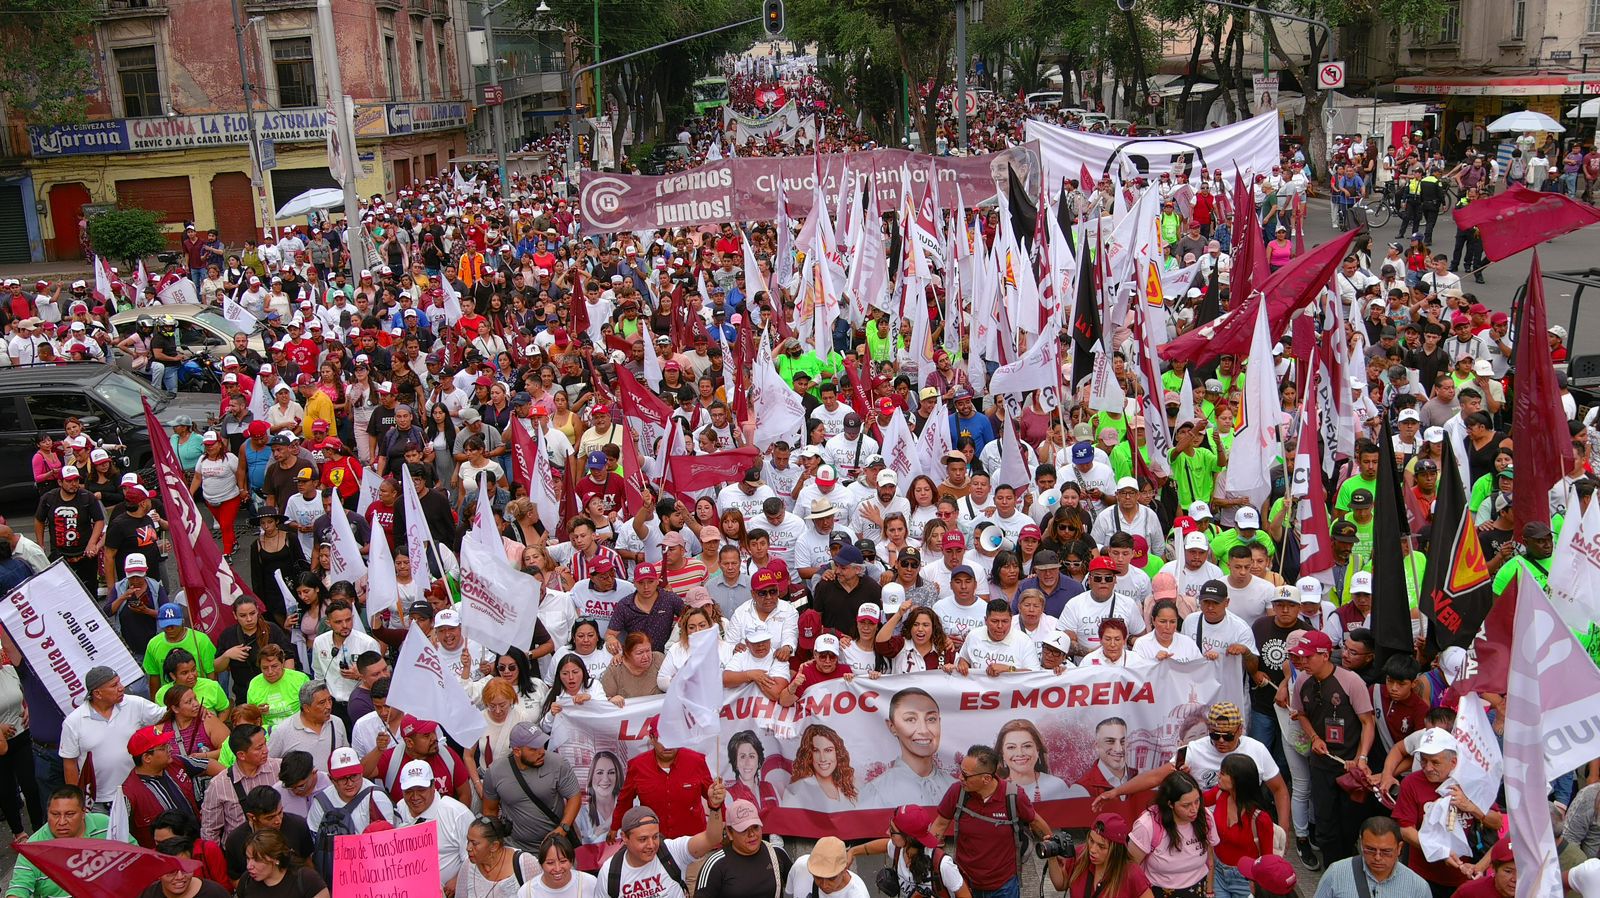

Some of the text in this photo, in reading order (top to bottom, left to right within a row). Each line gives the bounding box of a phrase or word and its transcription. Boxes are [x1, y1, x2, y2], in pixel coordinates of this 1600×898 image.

[133, 118, 196, 138] CANTINA
[201, 116, 219, 134] LA
[262, 112, 328, 131] ASTURIAN
[656, 195, 732, 226] juntos!
[11, 591, 47, 639] Clara
[586, 600, 618, 610] CATY
[942, 615, 983, 628] CLAUDIA
[1192, 632, 1229, 649] CAUDIA
[973, 648, 1015, 663] CLAUDIA
[720, 689, 880, 723] AUHTEMOC
[960, 691, 1000, 711] ES
[1010, 681, 1155, 709] MORENA
[359, 857, 428, 884] Cuauhtémoc
[623, 873, 661, 895] CATY
